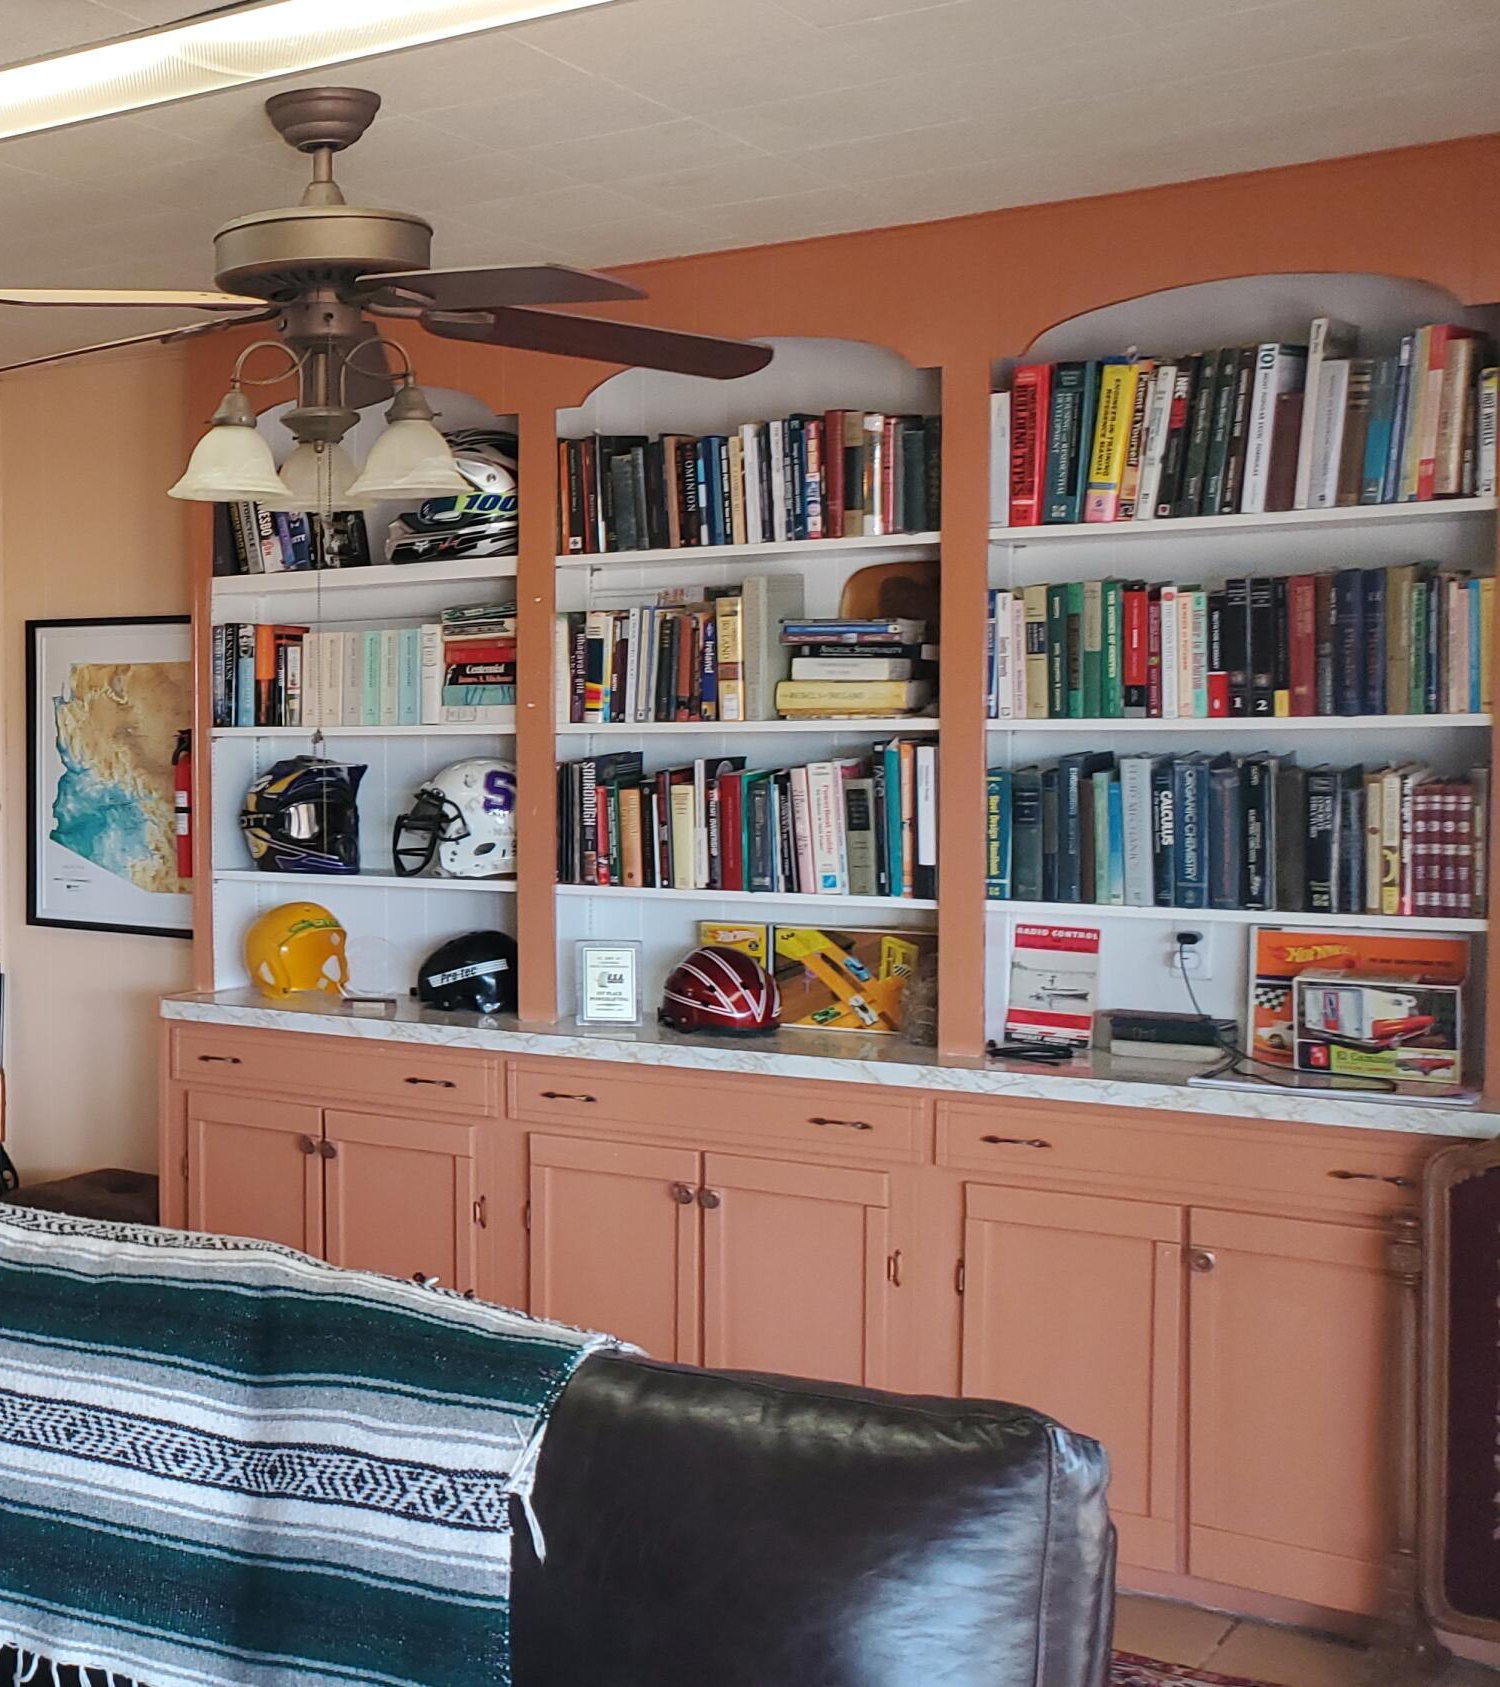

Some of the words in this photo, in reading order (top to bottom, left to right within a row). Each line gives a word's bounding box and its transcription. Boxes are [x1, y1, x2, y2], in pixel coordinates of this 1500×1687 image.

[1259, 346, 1276, 370] 101
[1134, 373, 1148, 411] Patent
[1174, 375, 1189, 399] NEC
[1013, 384, 1029, 450] BUILDING
[1127, 422, 1142, 466] Yourself
[684, 452, 697, 512] DOMINION
[1012, 454, 1027, 497] TYPES
[466, 663, 505, 674] Centennial
[704, 640, 715, 674] Ireland
[1233, 697, 1242, 708] 1
[1255, 699, 1268, 711] 2
[483, 770, 517, 814] S
[582, 761, 597, 826] SOURDOUGH
[1184, 769, 1197, 823] ORGANIC
[987, 814, 1000, 840] Design
[1160, 790, 1174, 846] CALCULUS
[709, 818, 718, 857] OWNERSHIP
[825, 830, 835, 855] Guide
[1184, 824, 1197, 881] CHEMISTRY
[988, 840, 1000, 876] Handbook
[1016, 927, 1049, 936] RADIO
[1051, 929, 1098, 940] CONTROL
